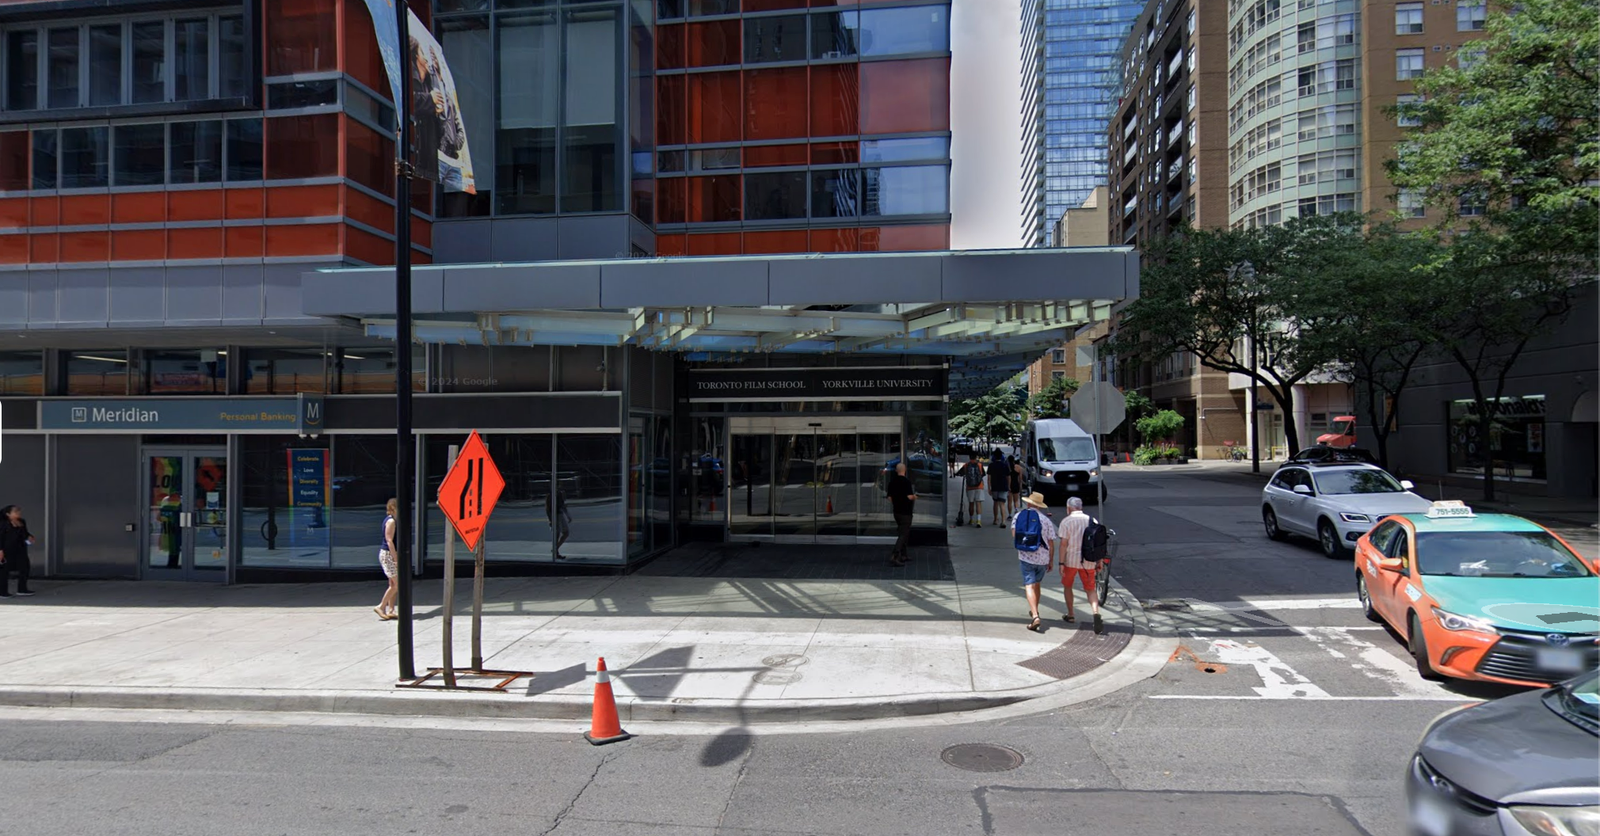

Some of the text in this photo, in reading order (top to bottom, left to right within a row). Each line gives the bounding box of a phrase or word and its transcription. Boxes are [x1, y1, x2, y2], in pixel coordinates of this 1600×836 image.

[696, 380, 807, 390] TORONTO FILM SCHOOL
[822, 379, 933, 389] YORKVILLE UNIVERSITY
[92, 407, 159, 422] Meridian
[307, 402, 319, 419] M
[220, 411, 296, 423] Personal Banking
[1435, 508, 1470, 516] 751-5555
